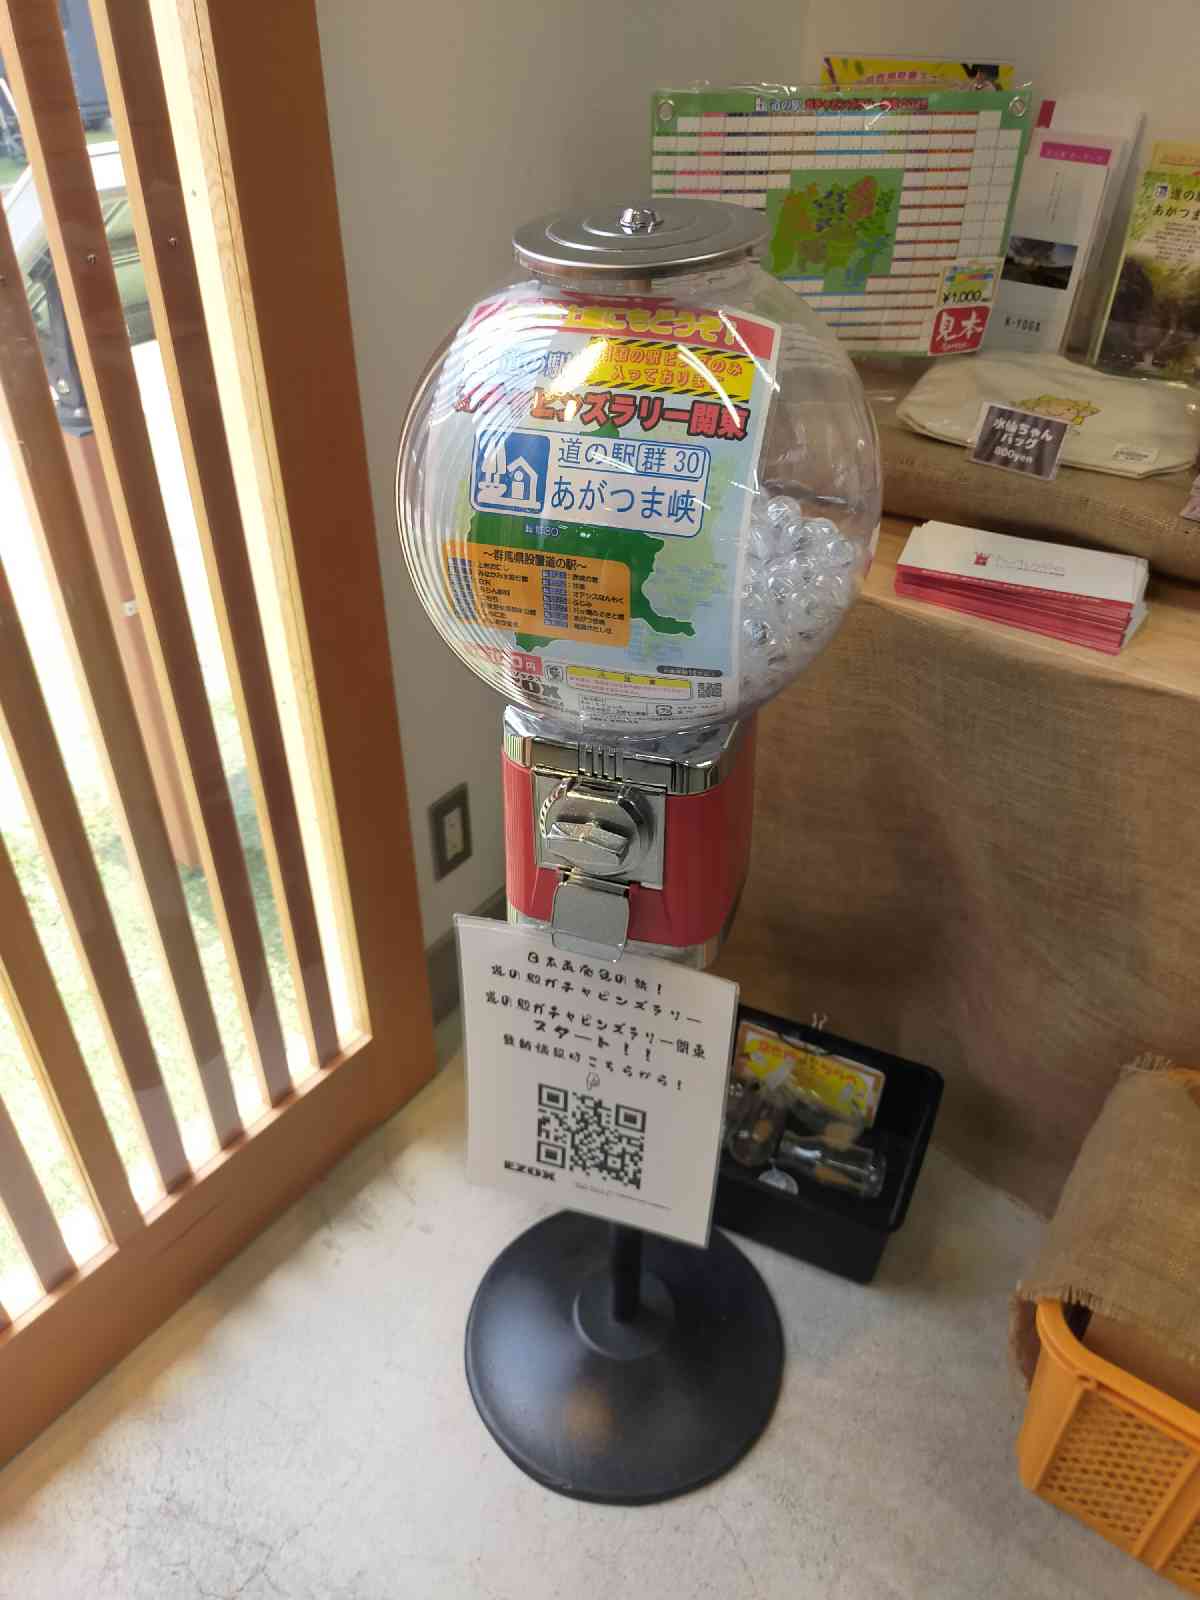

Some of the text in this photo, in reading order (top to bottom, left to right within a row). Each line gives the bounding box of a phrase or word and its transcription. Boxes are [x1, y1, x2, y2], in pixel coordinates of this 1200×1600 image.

[935, 309, 984, 342] 見本
[557, 437, 637, 469] 道の駅
[550, 475, 697, 525] あがつま峡
[503, 1159, 556, 1182] EZOX
